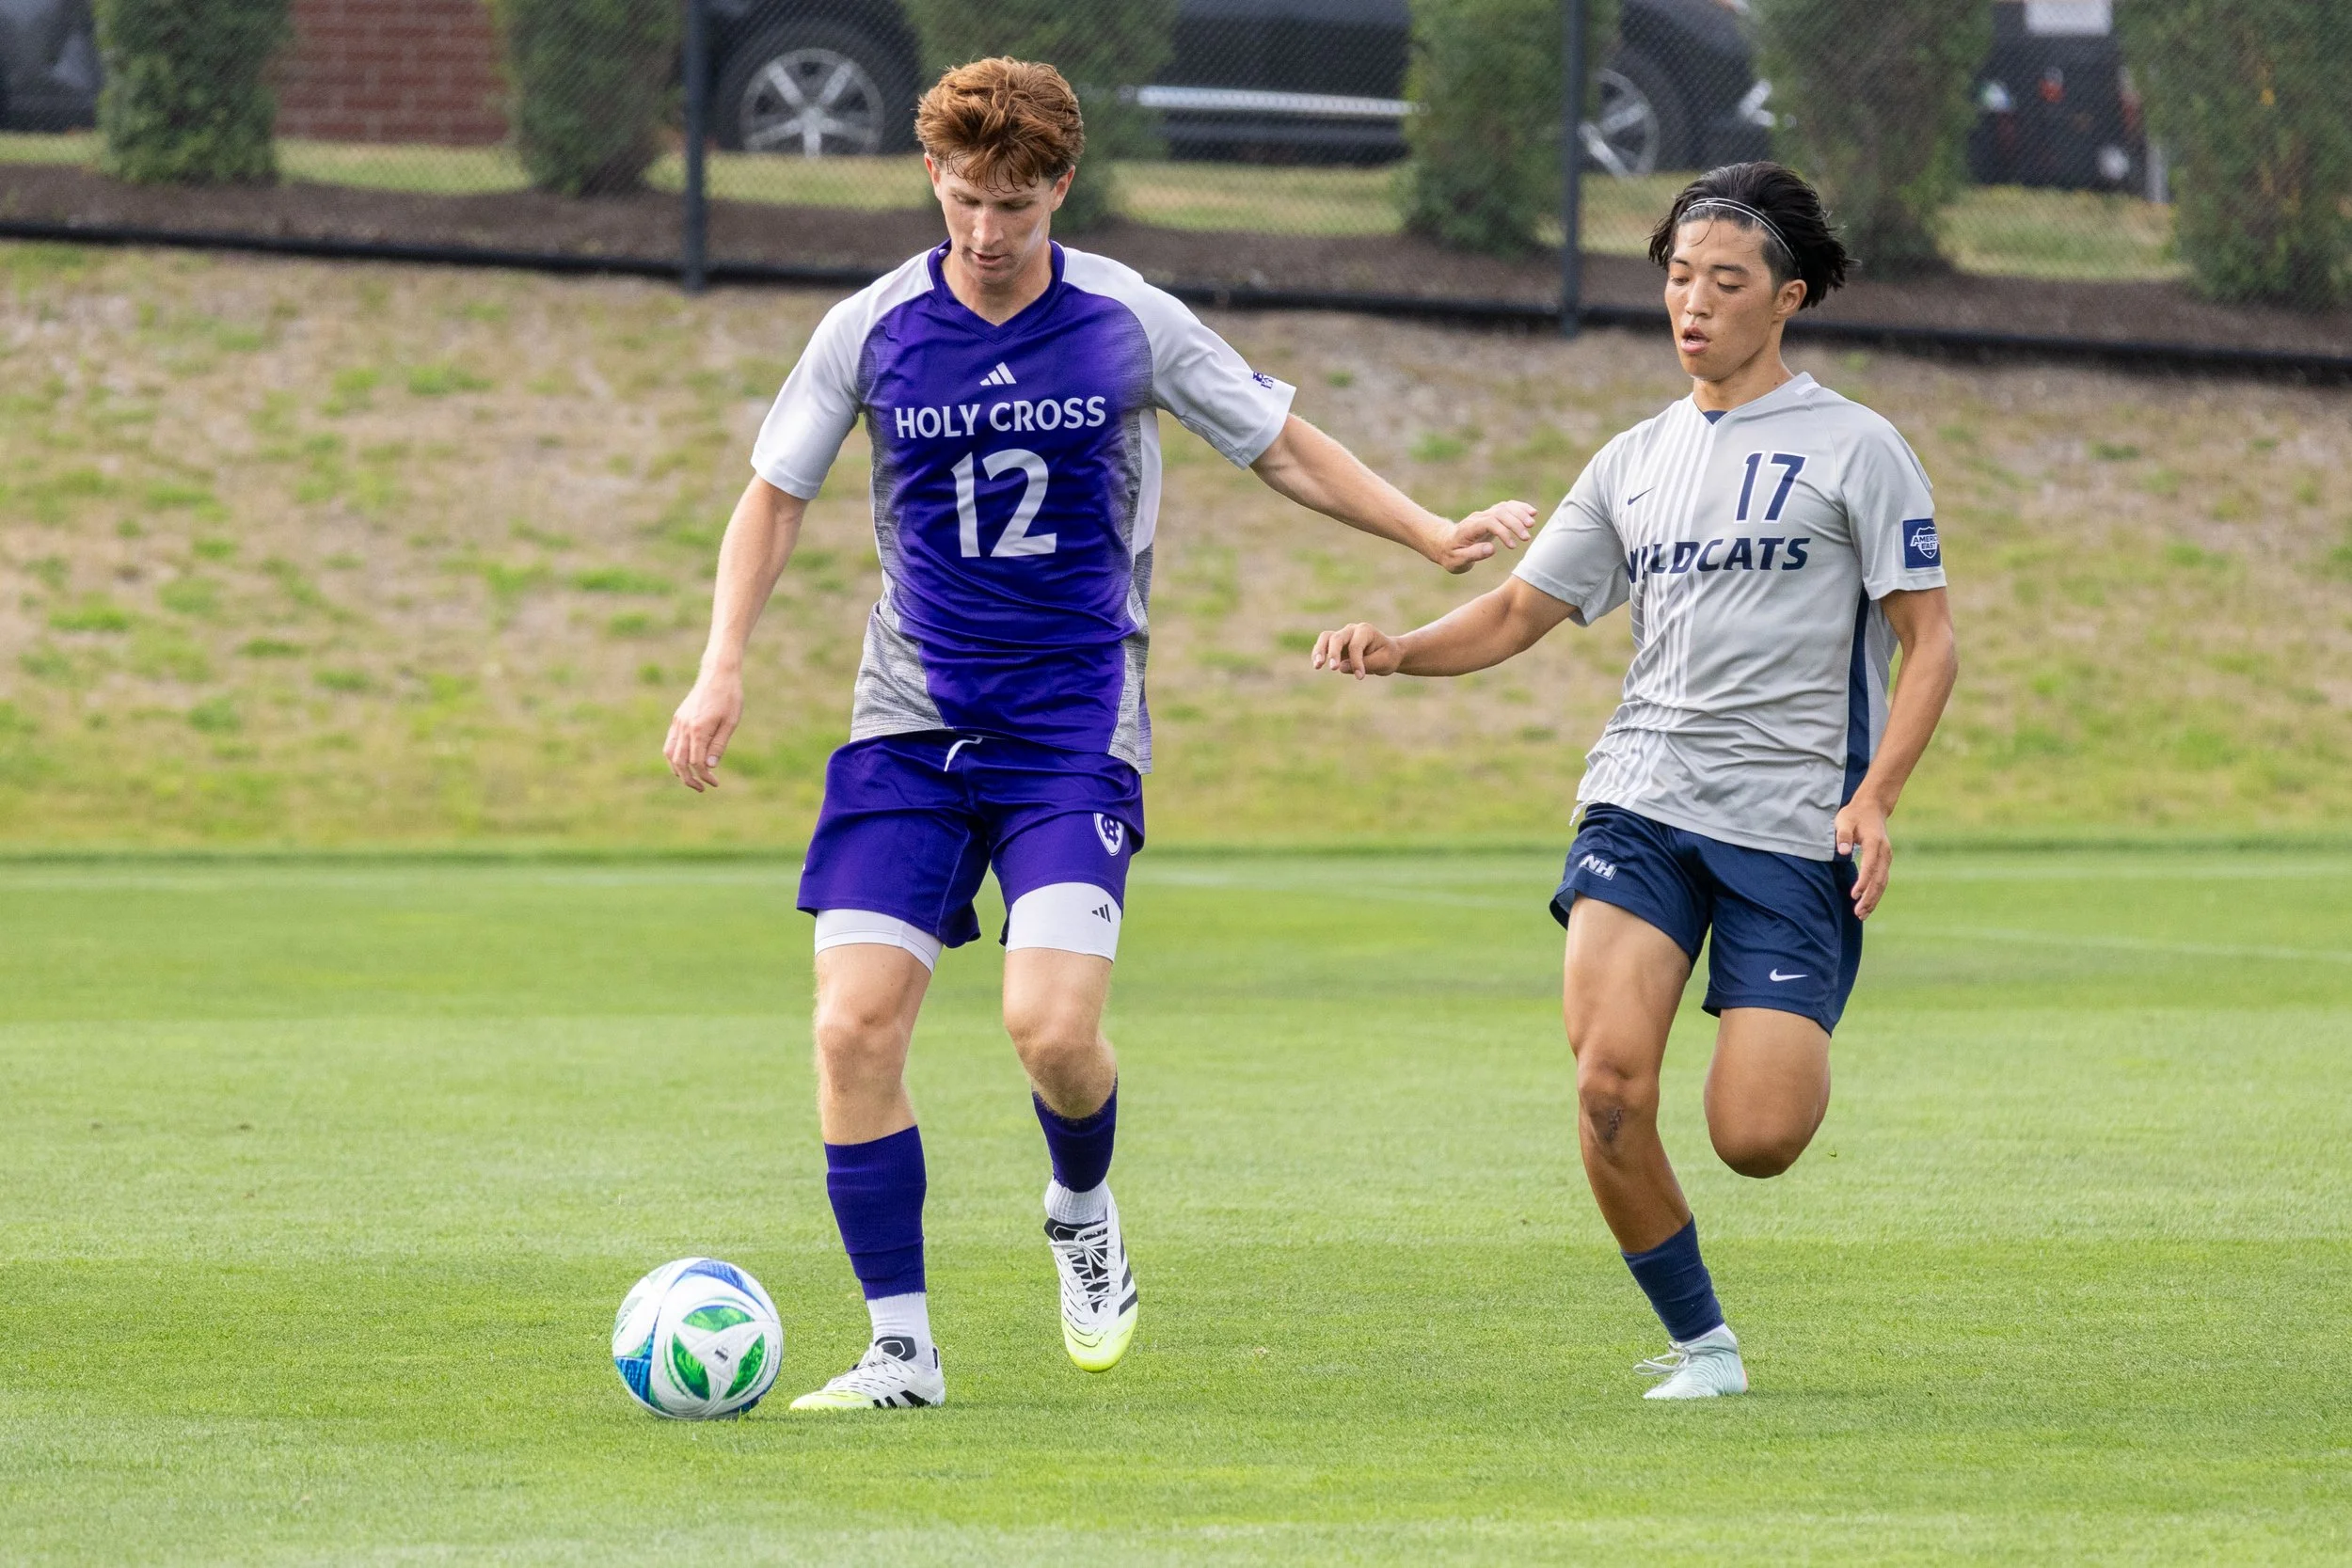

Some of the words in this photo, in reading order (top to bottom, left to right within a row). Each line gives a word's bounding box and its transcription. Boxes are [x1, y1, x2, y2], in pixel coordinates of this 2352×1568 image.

[895, 404, 981, 438] HOLY
[989, 395, 1106, 432] CROSS
[950, 448, 1057, 558] 12
[1734, 451, 1808, 523] 17
[1579, 853, 1617, 879] NH
